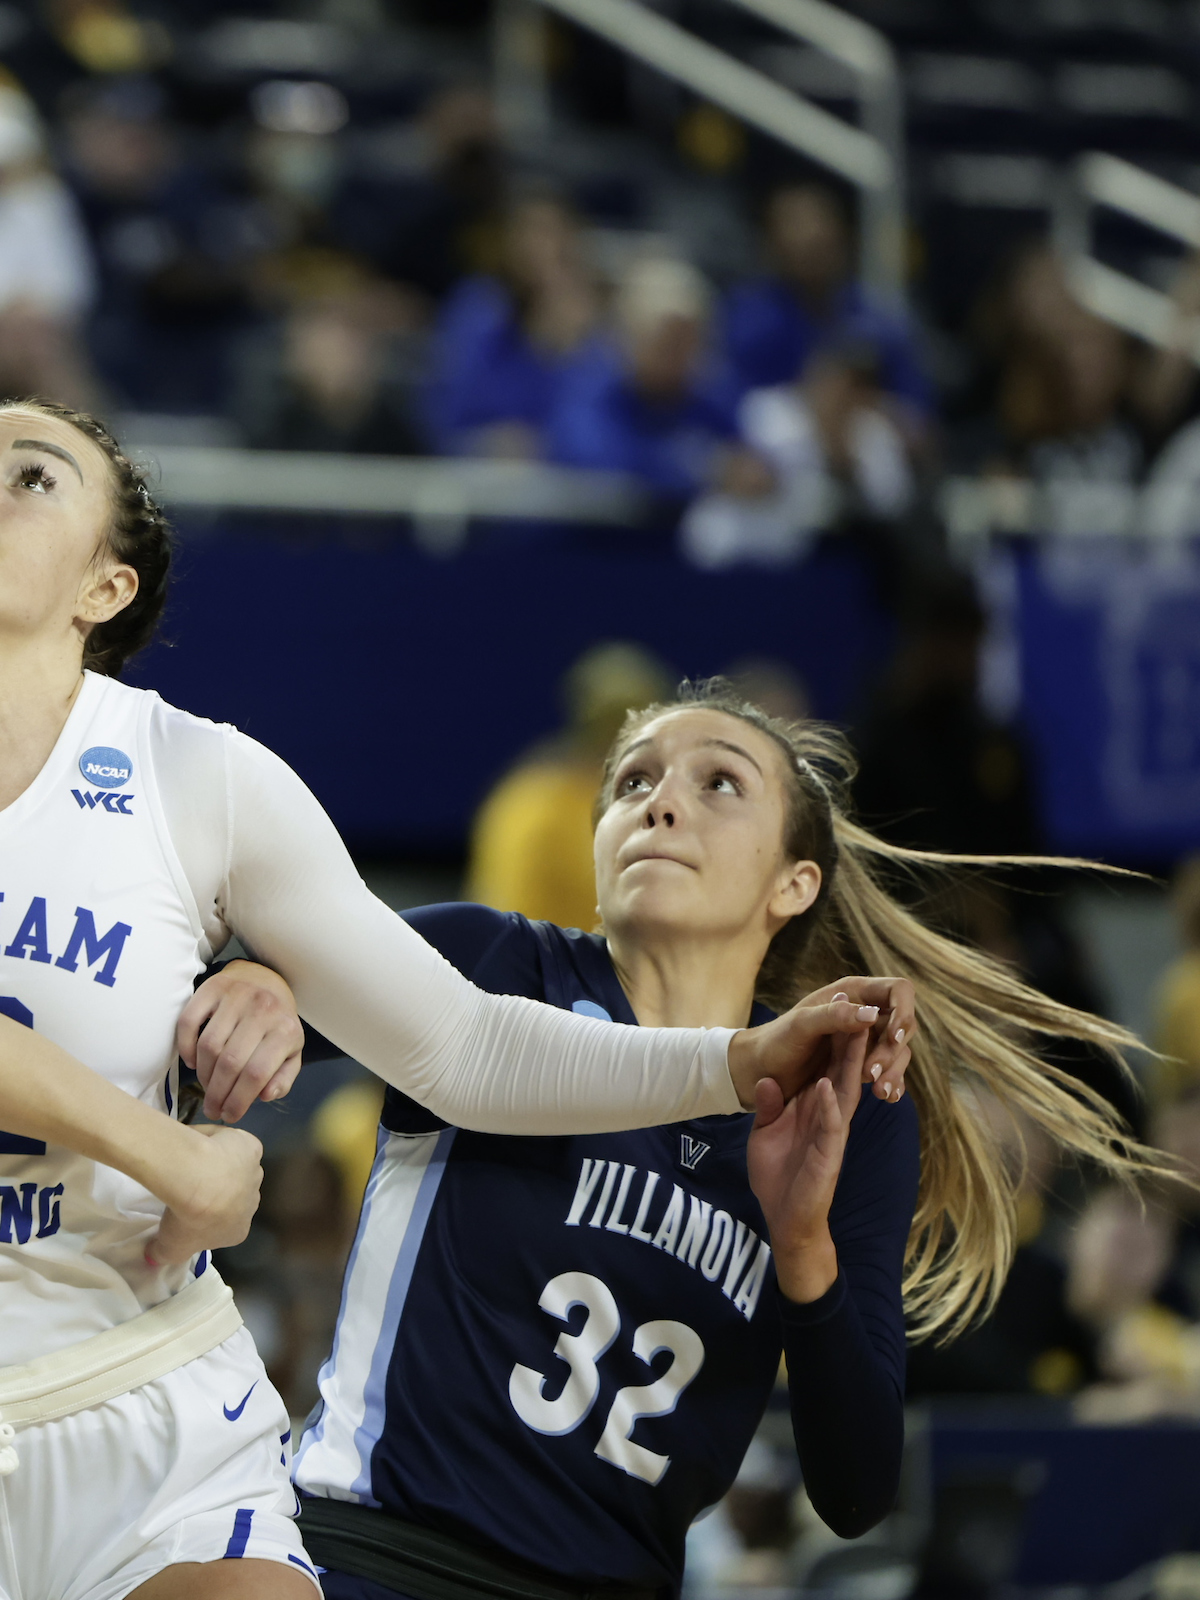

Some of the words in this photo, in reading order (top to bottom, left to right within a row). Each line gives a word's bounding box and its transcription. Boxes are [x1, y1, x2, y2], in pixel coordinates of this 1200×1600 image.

[70, 789, 135, 815] WCC
[85, 763, 129, 779] NCAA
[565, 1157, 772, 1323] VILLANOVA
[508, 1271, 705, 1486] 32
